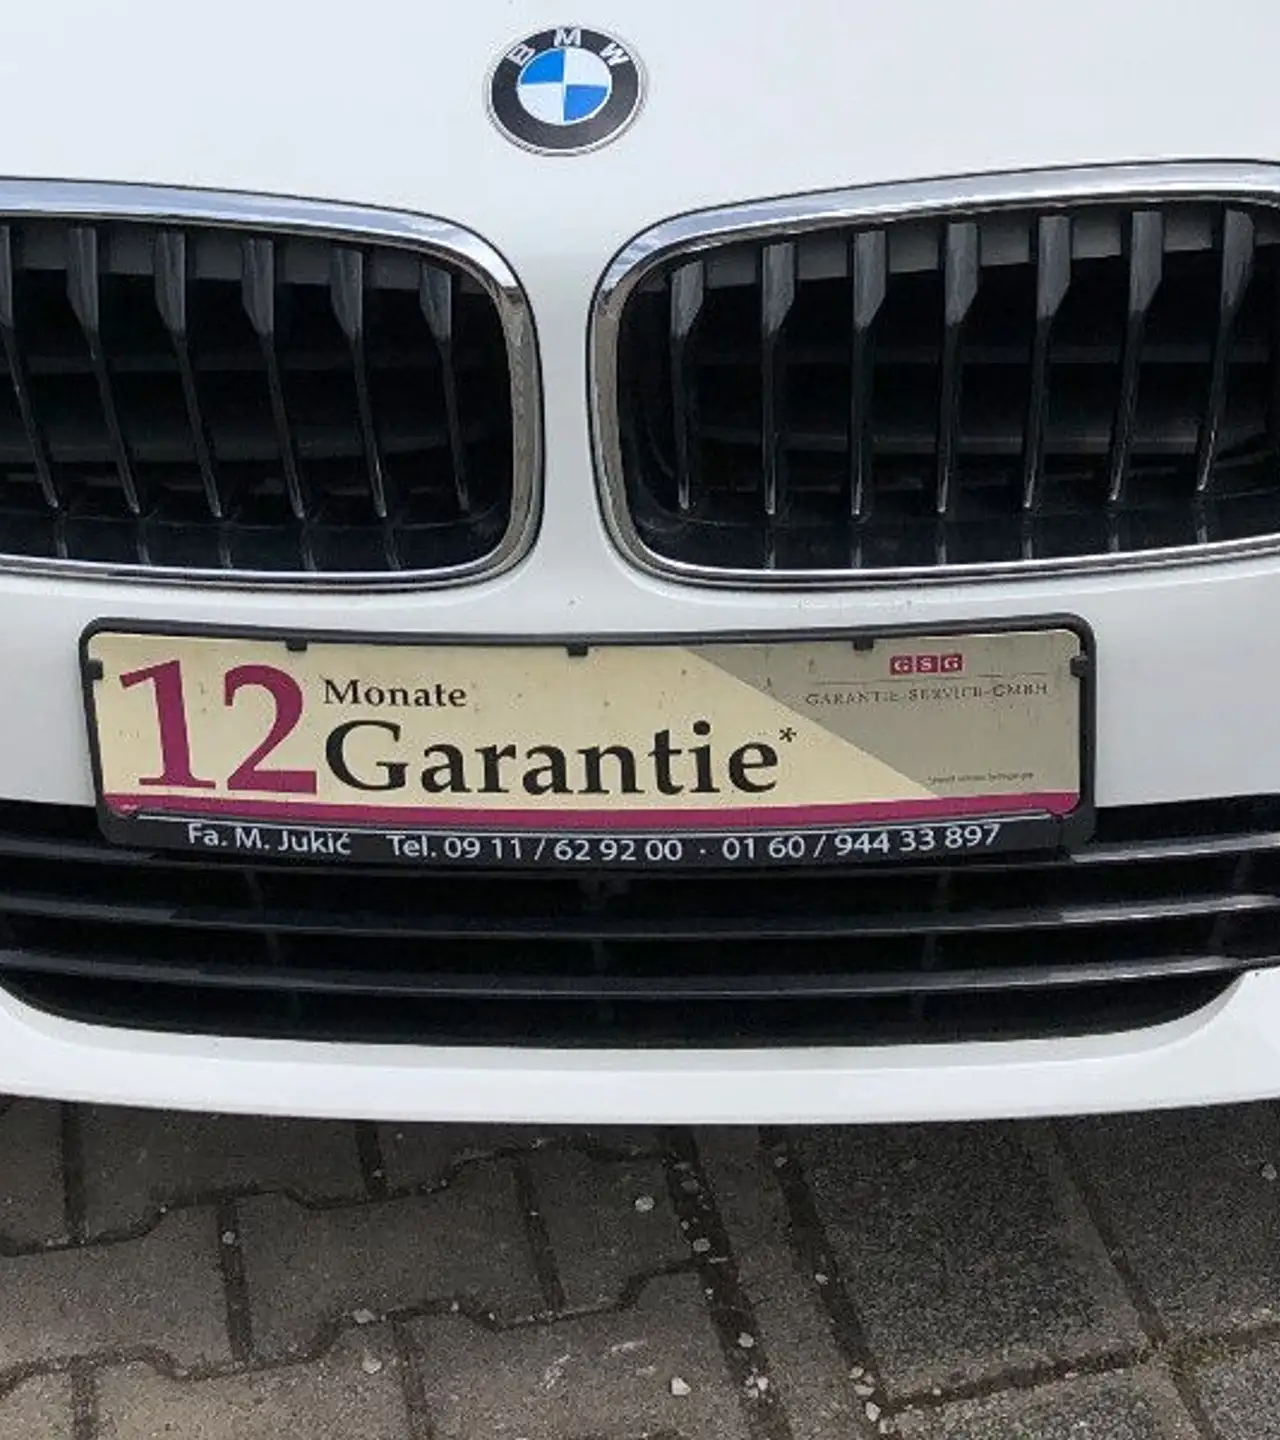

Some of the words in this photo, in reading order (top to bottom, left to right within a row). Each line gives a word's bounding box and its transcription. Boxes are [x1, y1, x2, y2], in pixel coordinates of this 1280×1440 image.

[506, 26, 630, 67] BMW
[323, 678, 468, 708] Monate
[119, 660, 318, 795] 12
[187, 822, 227, 847] Fa.
[235, 827, 270, 851] M.
[277, 830, 352, 856] Jukić
[386, 834, 437, 858] Tel.
[443, 836, 480, 859] 09
[491, 837, 522, 859] 11
[553, 839, 591, 861] 62
[599, 839, 637, 861] 92
[645, 839, 683, 861] 00
[722, 837, 756, 860] 01
[768, 835, 805, 858] 60
[834, 831, 890, 855] 944
[899, 827, 936, 851] 33
[944, 823, 1001, 849] 897
